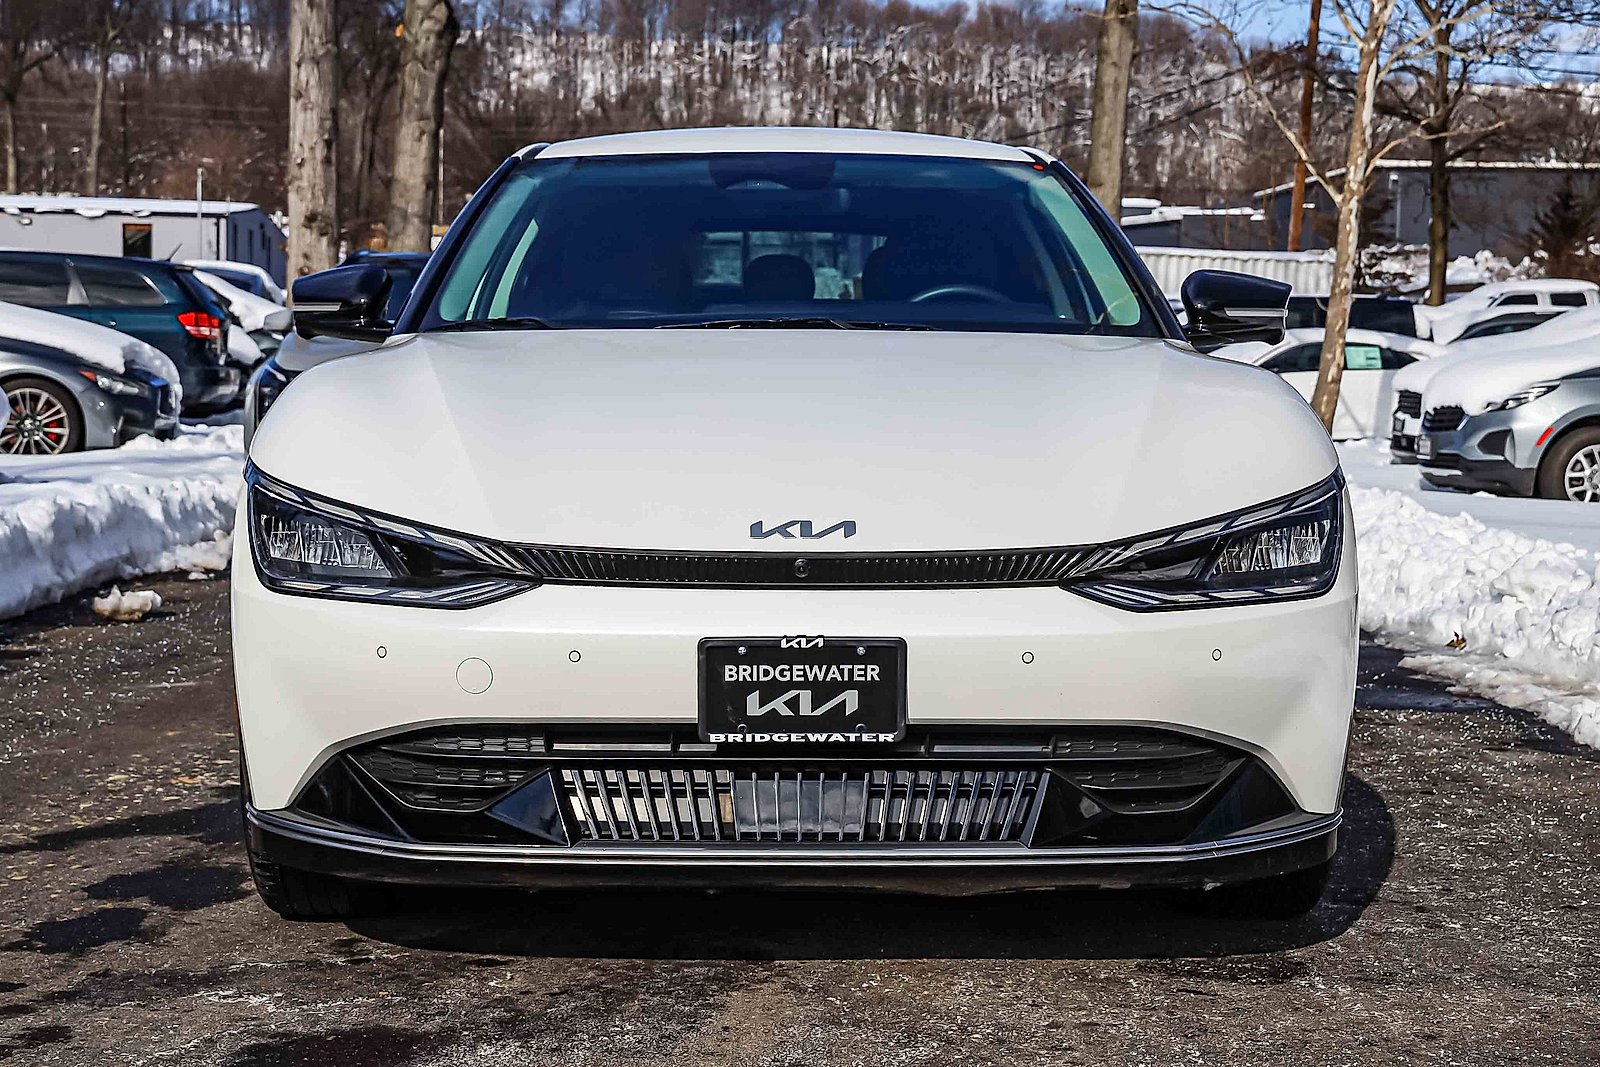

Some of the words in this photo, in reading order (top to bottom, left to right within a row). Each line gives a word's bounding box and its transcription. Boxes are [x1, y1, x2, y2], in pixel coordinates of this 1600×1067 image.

[750, 520, 856, 539] KIA
[781, 637, 824, 648] KIA
[724, 665, 881, 682] BRIDGEWATER
[747, 690, 859, 716] KIA
[709, 733, 895, 743] BRIDGEWATER
